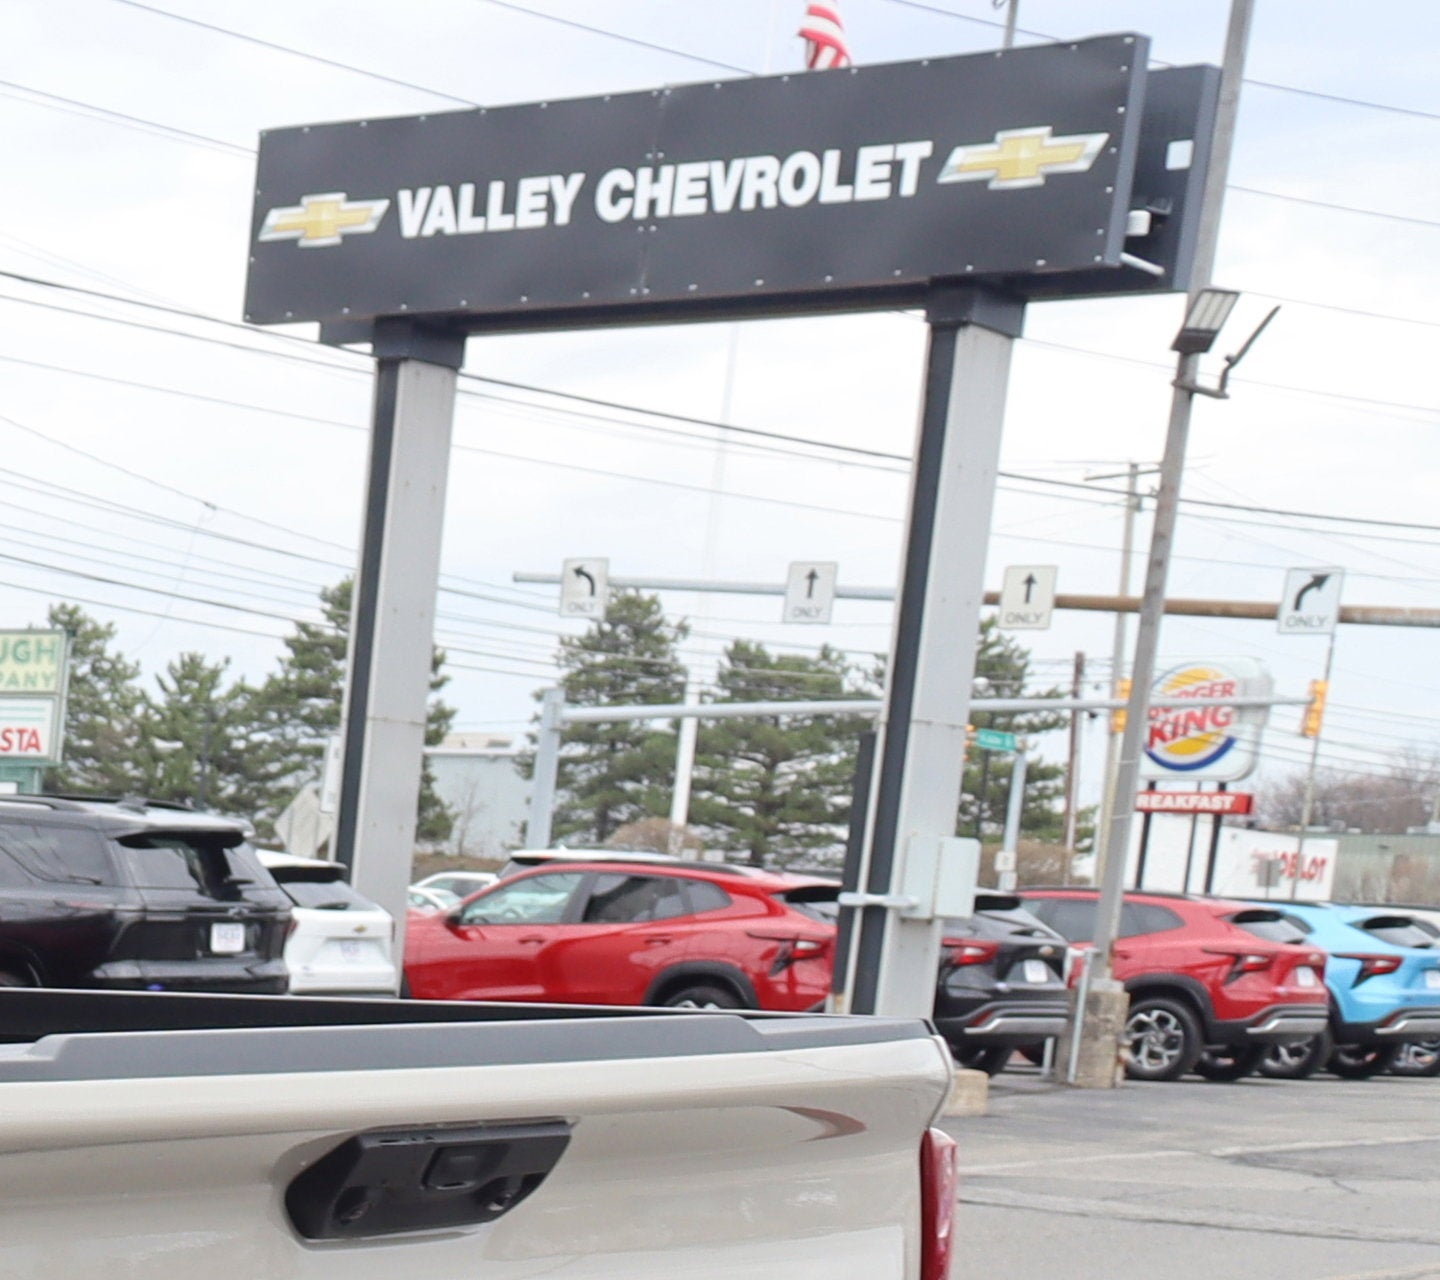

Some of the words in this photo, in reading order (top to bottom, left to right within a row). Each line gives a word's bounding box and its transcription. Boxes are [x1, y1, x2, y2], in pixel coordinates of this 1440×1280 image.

[397, 172, 586, 238] VALLEY
[594, 140, 933, 223] CHEVROLET
[791, 606, 823, 618] ONLY
[1005, 612, 1042, 624] ONLY
[1285, 614, 1327, 628] ONLY
[1148, 704, 1232, 749] KING
[1136, 793, 1236, 811] REAKFAST
